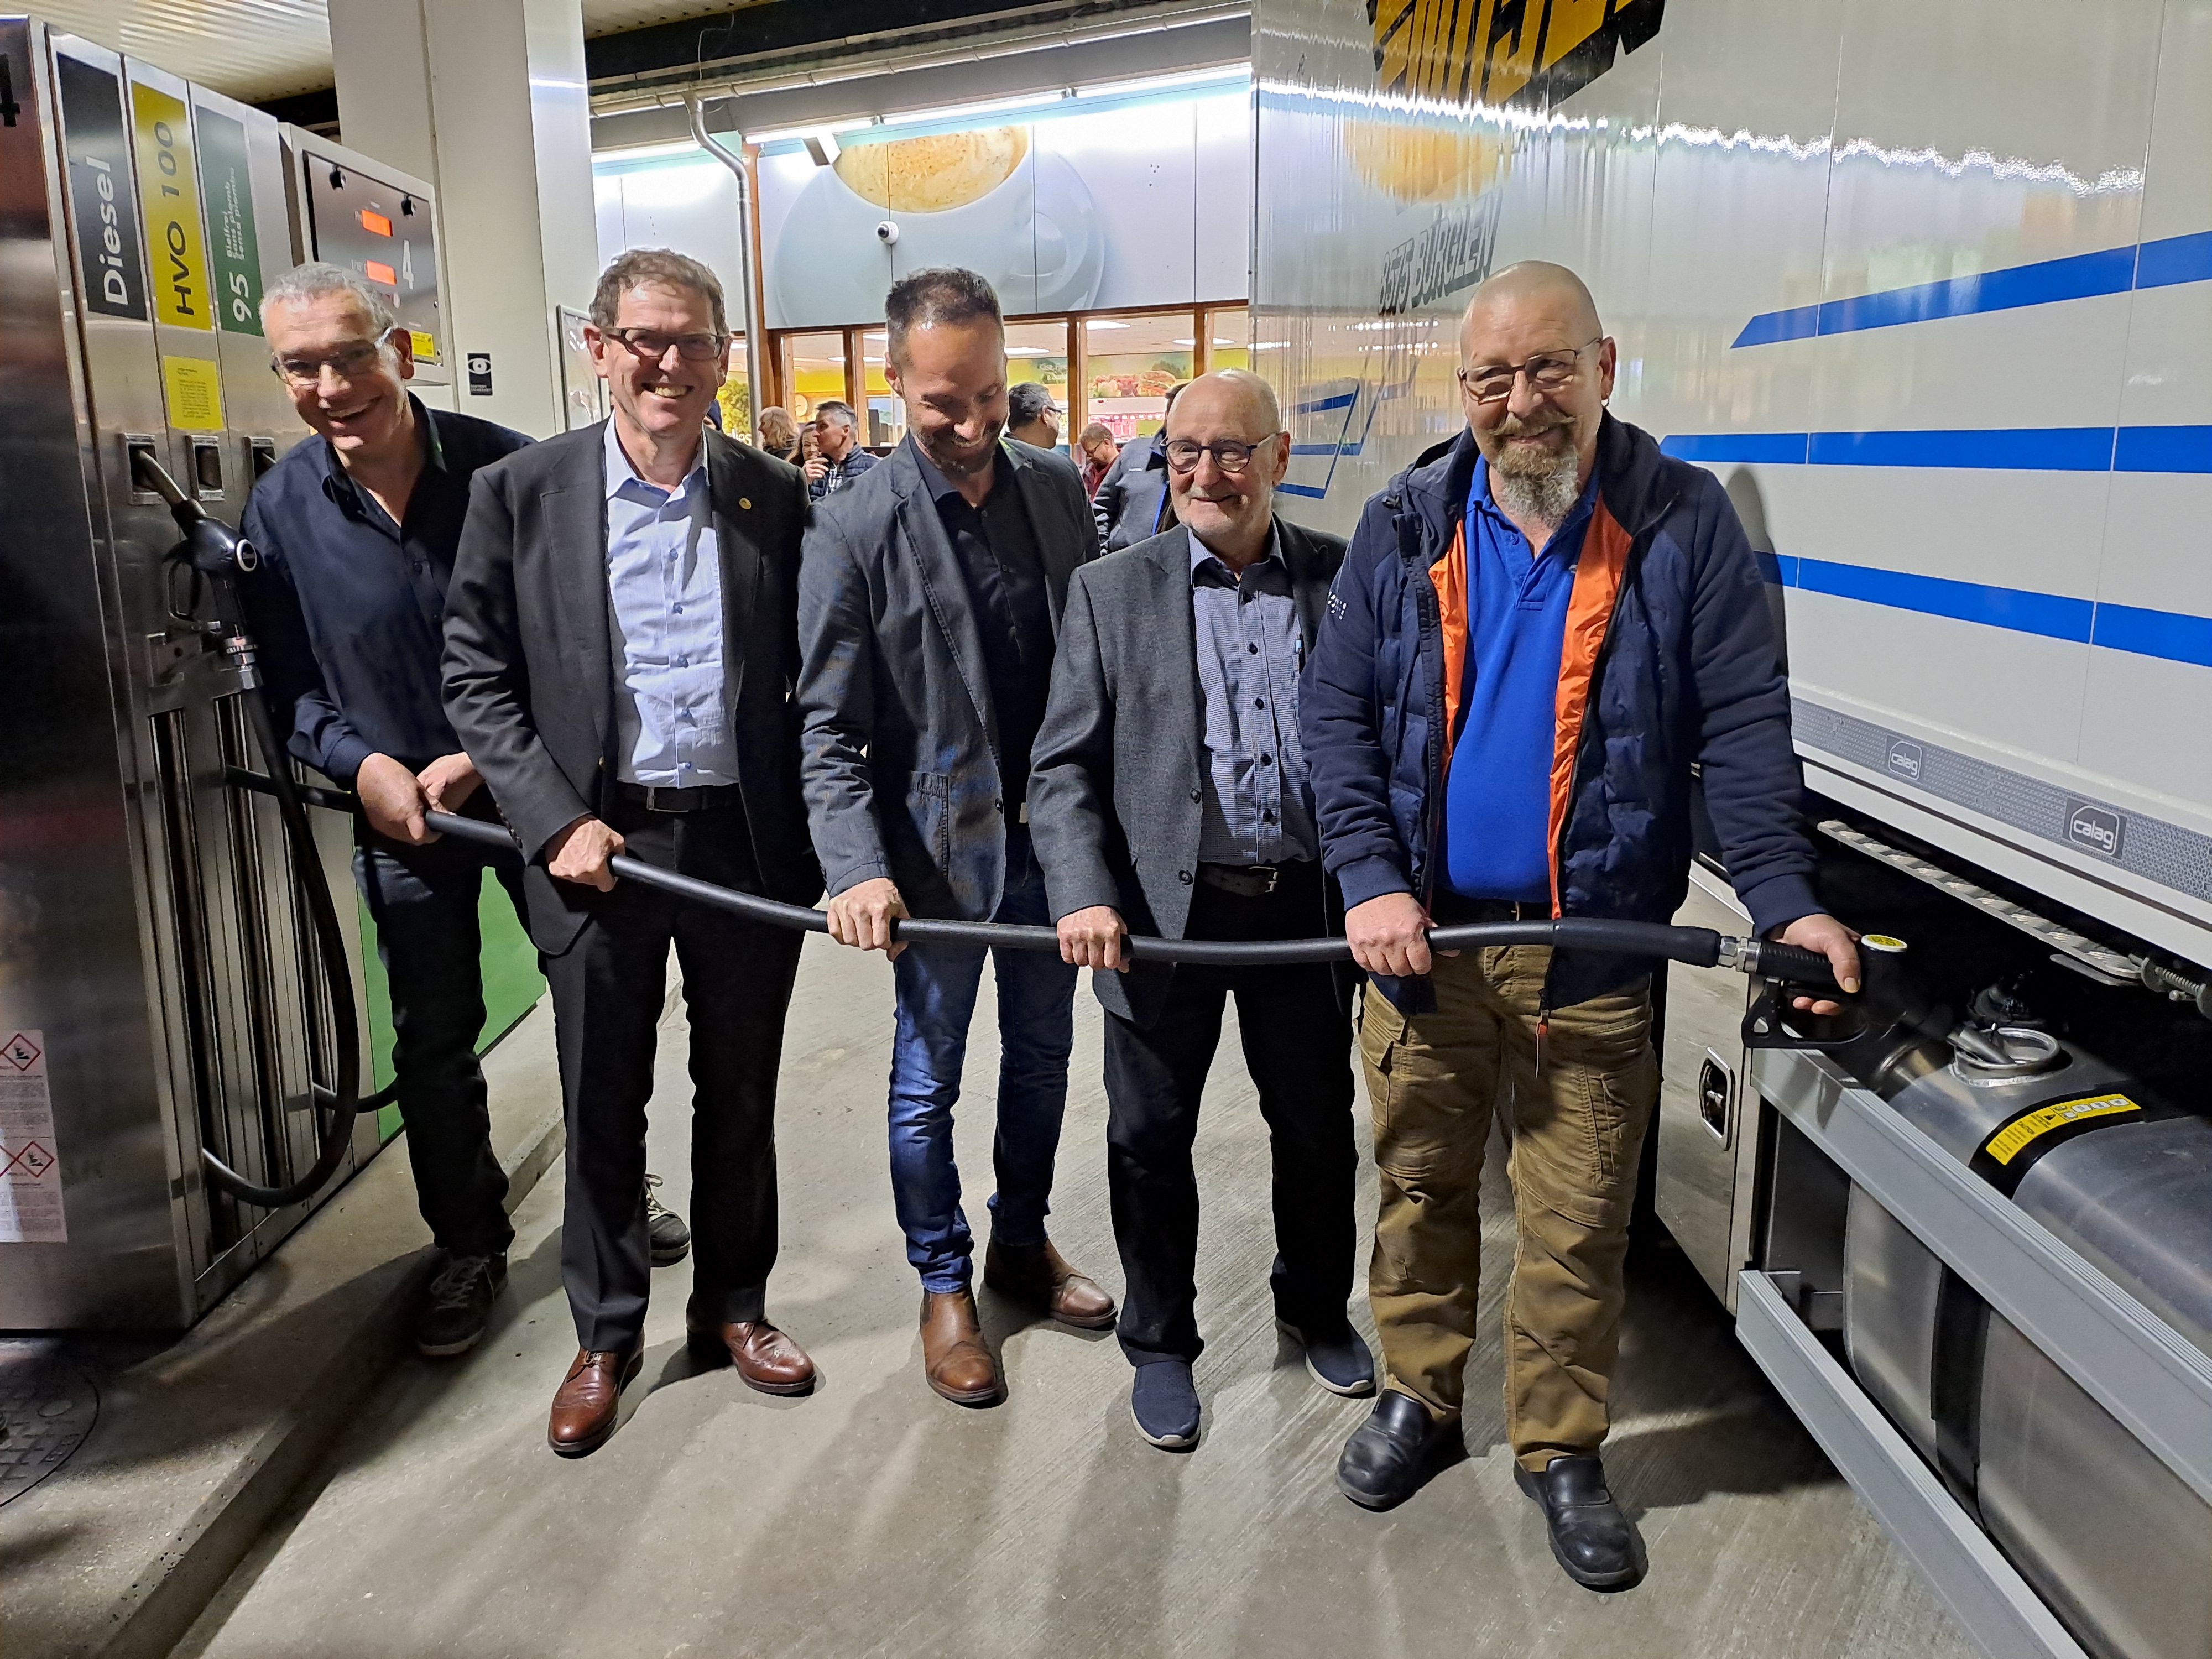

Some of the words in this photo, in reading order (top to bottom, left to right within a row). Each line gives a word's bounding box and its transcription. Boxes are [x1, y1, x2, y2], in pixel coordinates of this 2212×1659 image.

[154, 121, 180, 197] 100
[85, 155, 128, 305] Diesel
[166, 220, 195, 316] HVO
[402, 239, 414, 290] 4
[1378, 237, 1415, 316] 8575
[228, 271, 252, 322] 95
[1891, 752, 1918, 776] calag
[2073, 819, 2114, 850] calag
